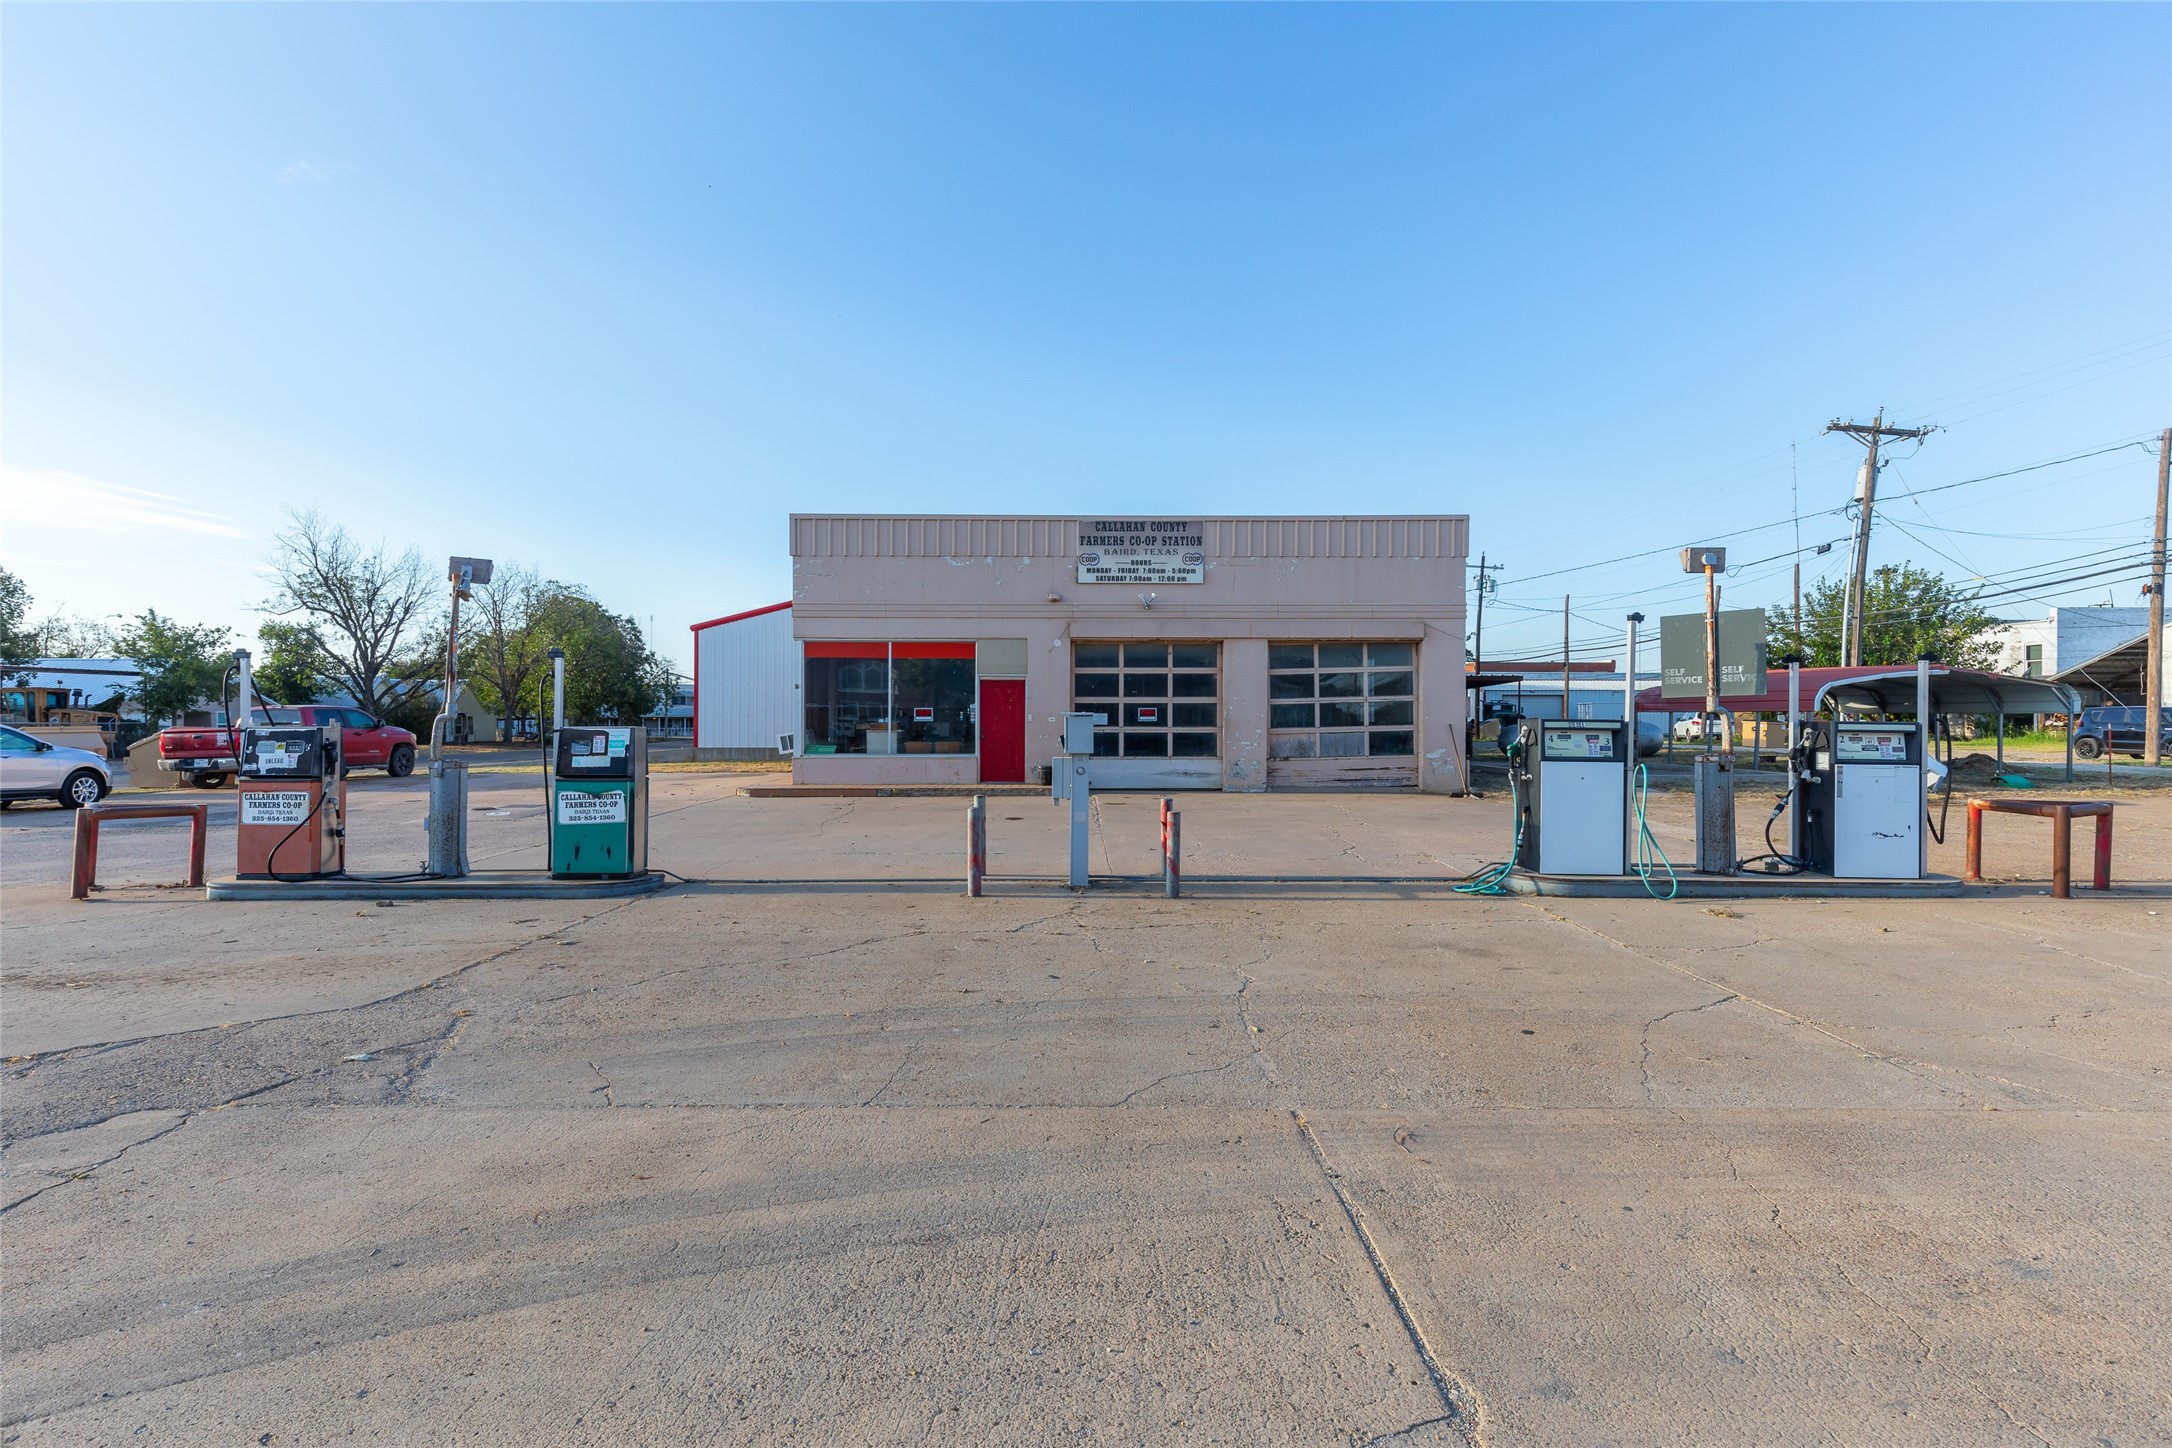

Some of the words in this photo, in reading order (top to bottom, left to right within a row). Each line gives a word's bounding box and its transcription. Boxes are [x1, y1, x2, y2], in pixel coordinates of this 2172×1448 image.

[1095, 521, 1146, 532] CALLAHAN
[1150, 521, 1188, 532] COUNTY
[1080, 535, 1125, 546] FARMERS
[1129, 535, 1157, 546] CO-OP
[1161, 535, 1203, 546] STATION
[1104, 548, 1140, 556] BAIRD,
[1143, 548, 1179, 556] TEXAS
[1171, 567, 1197, 575] 5:00pm
[1664, 668, 1686, 676] SELF
[1721, 665, 1745, 674] SELF
[1664, 676, 1703, 685] SERVICE
[1548, 735, 1554, 743] 4
[1604, 737, 1610, 746] 3
[1839, 735, 1845, 743] 2
[244, 793, 281, 801] CALLAHAN
[282, 793, 307, 801] COUNTY
[248, 801, 281, 809] FARMERS
[282, 801, 303, 809] CO-OP
[565, 801, 597, 809] FARMERS
[598, 800, 619, 808] CO-OP
[568, 814, 616, 822] 325-854-1360
